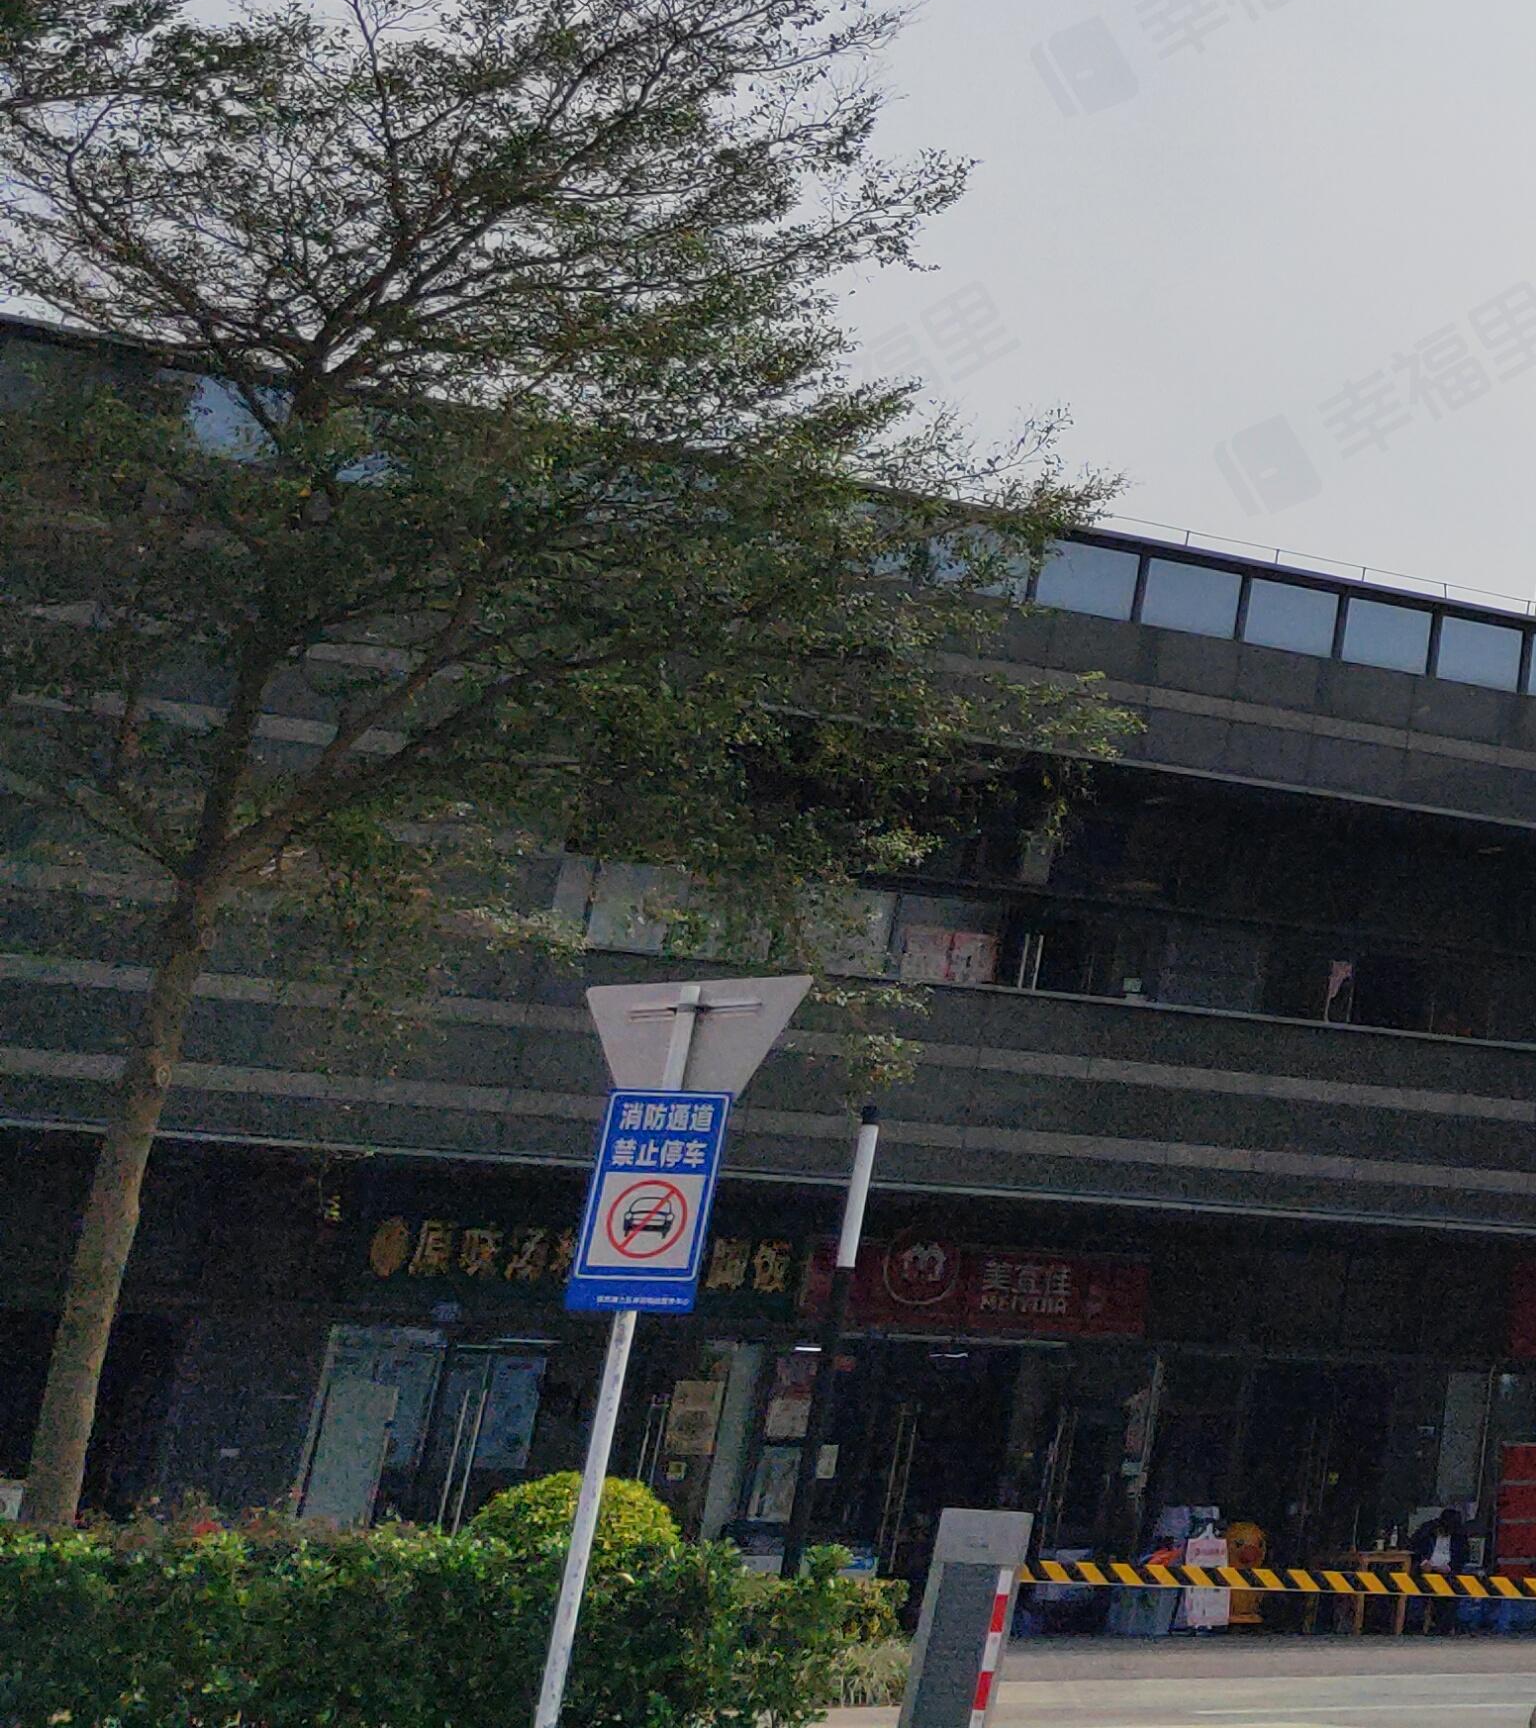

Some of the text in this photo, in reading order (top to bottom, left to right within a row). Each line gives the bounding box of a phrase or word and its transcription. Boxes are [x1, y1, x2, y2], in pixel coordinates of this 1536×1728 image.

[619, 1102, 715, 1132] 消防通道
[611, 1138, 707, 1168] 禁止停车
